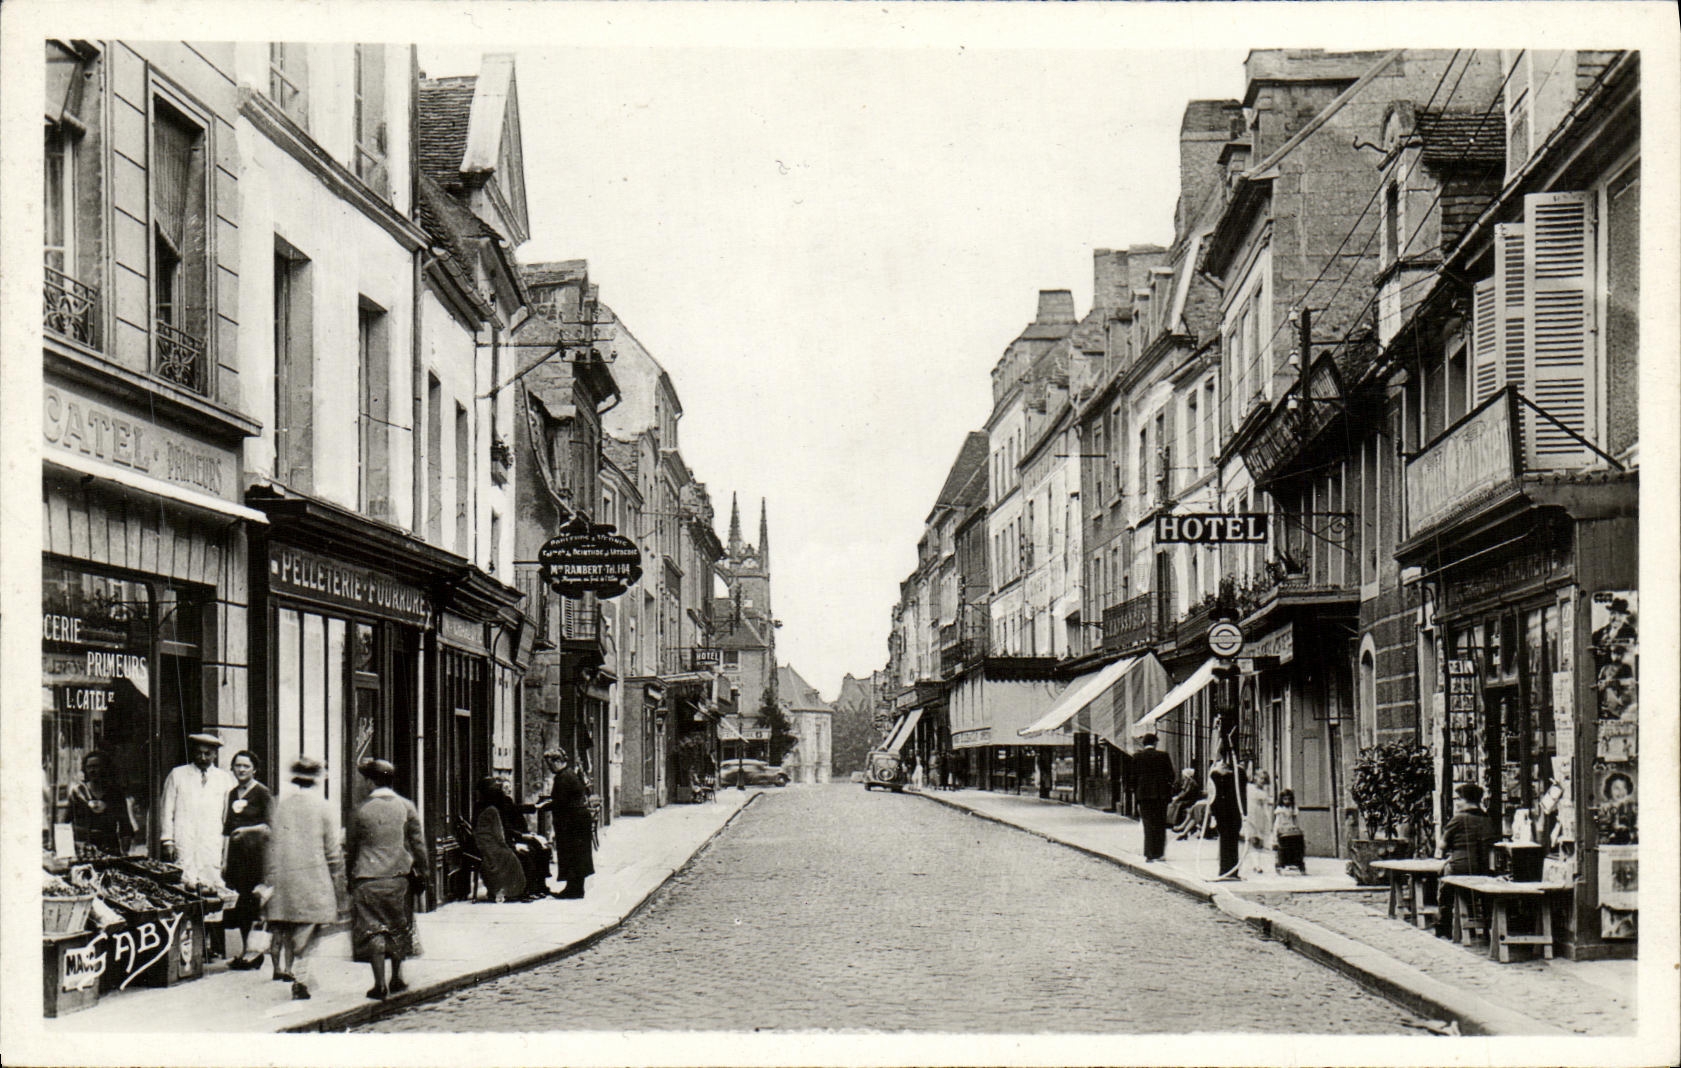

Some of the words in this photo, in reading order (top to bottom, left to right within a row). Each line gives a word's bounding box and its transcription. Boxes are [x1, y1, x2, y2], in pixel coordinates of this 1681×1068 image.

[43, 388, 149, 474] CATEL
[1159, 516, 1265, 541] HOTEL
[281, 551, 362, 601] PELLETERIE
[565, 564, 602, 575] RAMBERT
[43, 614, 82, 644] CERIE
[86, 651, 148, 680] PRIMEURS
[696, 651, 719, 661] HOTEL
